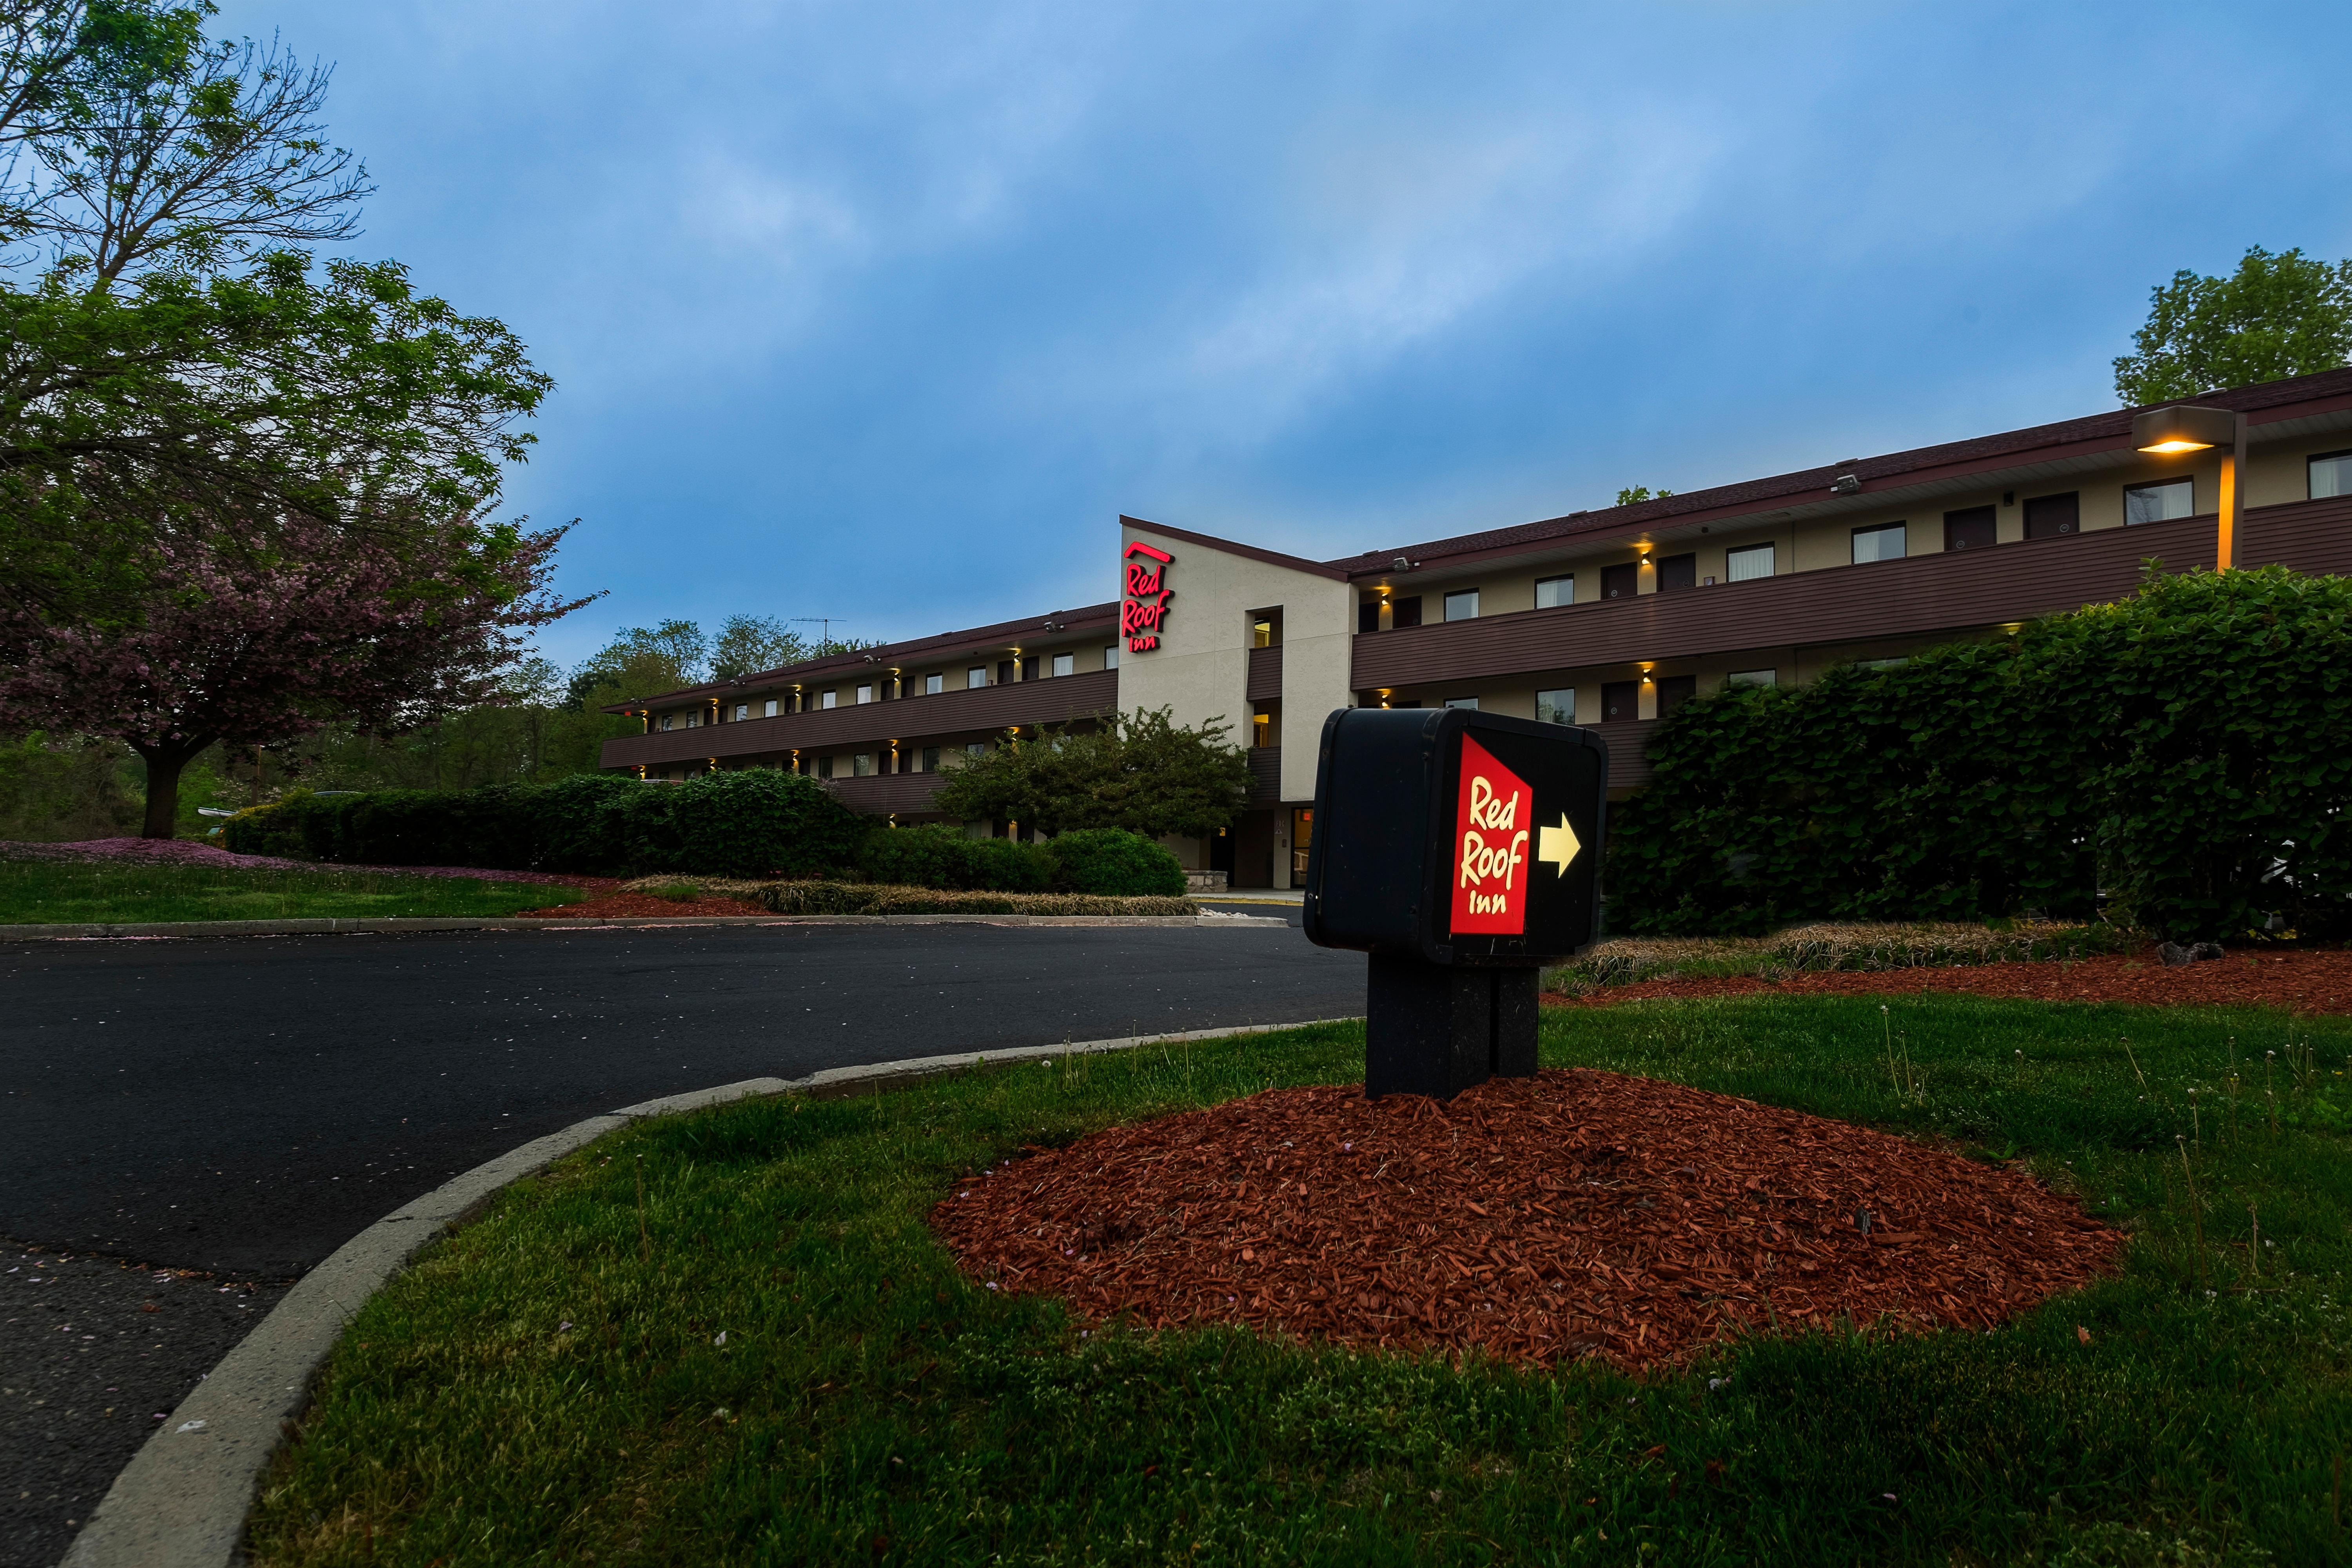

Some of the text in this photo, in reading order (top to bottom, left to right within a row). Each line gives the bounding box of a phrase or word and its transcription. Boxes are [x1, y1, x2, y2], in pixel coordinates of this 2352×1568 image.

[1126, 563, 1162, 597] Red
[1122, 589, 1170, 637] Roof
[1129, 635, 1156, 653] Inn
[1470, 776, 1519, 831] Red
[1460, 830, 1528, 891] Roof
[1469, 889, 1507, 915] Inn
